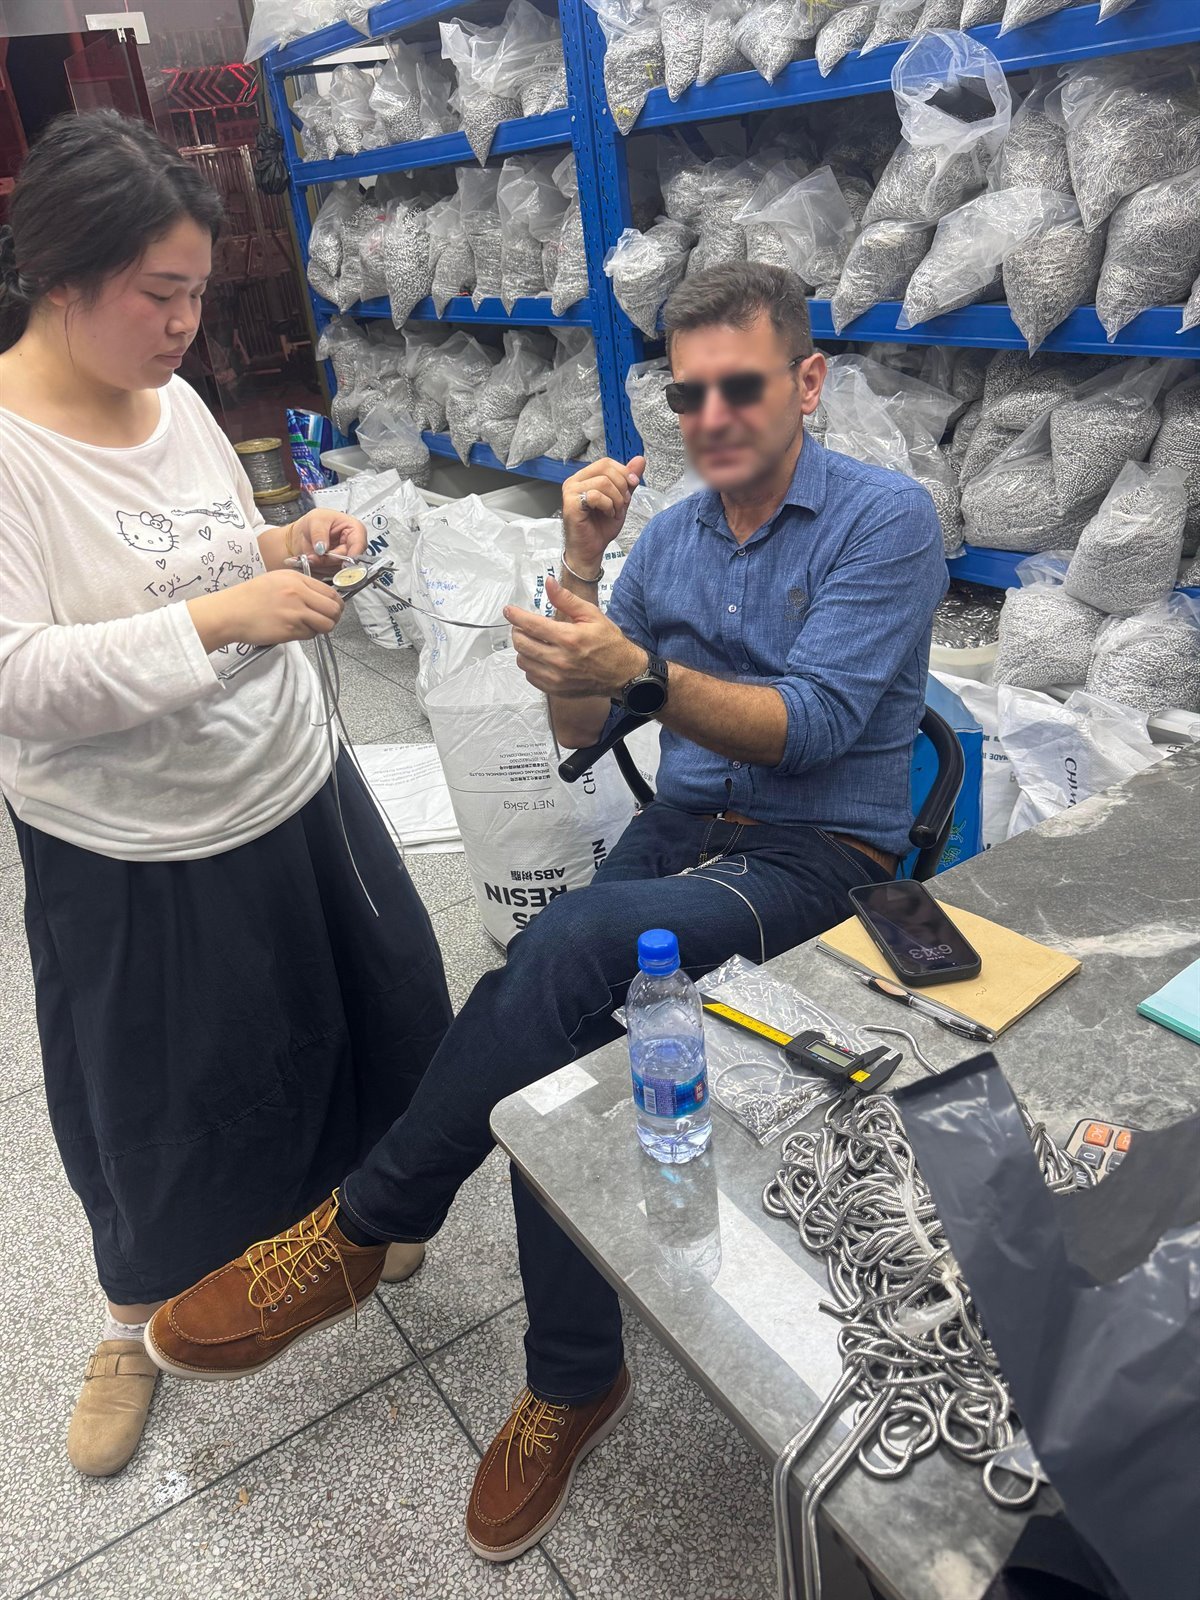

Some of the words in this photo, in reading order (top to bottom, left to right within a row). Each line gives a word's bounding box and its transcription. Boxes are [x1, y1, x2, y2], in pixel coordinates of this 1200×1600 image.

[143, 573, 182, 598] Toy's
[503, 800, 530, 811] 25kg
[532, 799, 555, 811] NET
